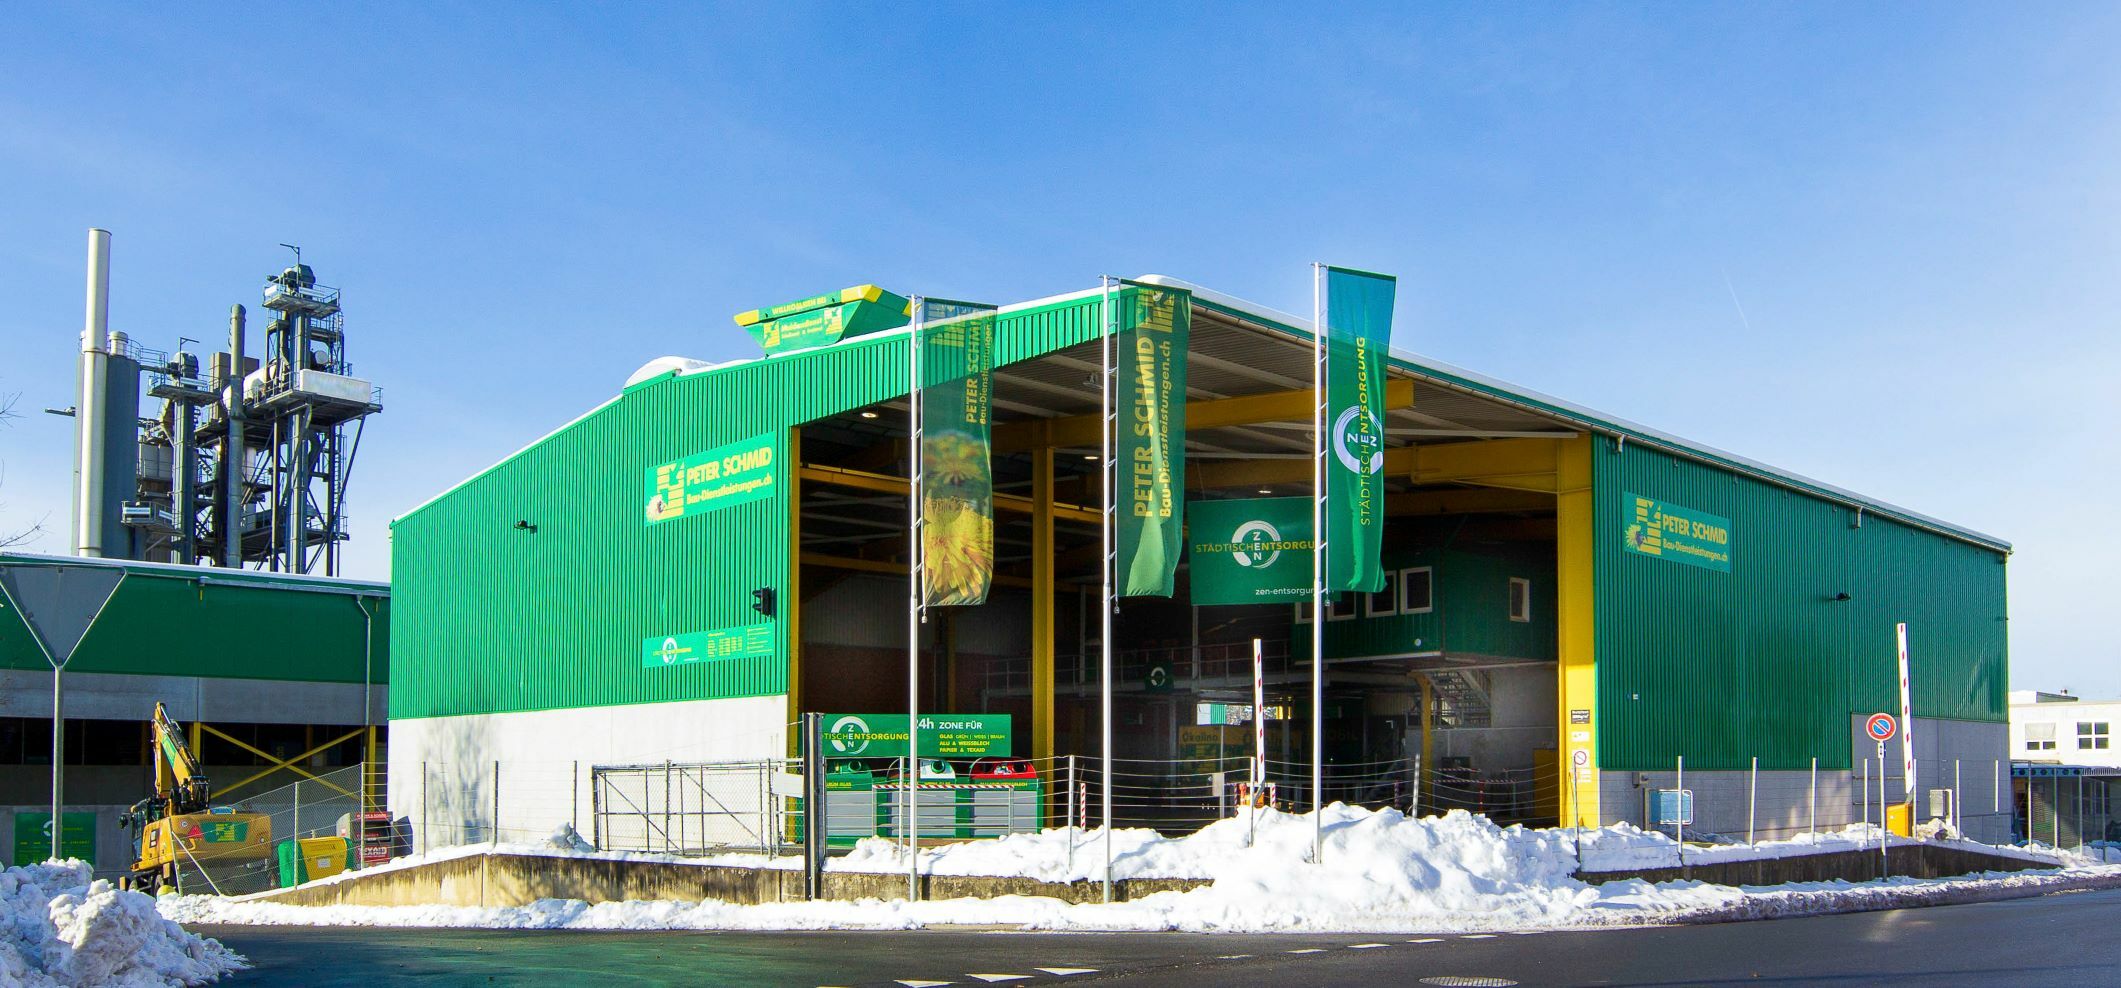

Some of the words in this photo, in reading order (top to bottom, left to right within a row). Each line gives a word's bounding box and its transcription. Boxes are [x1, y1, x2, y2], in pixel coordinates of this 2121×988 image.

[967, 312, 982, 373] SCHMI
[966, 378, 978, 423] PETER
[1134, 336, 1155, 438] SCHMID
[1158, 340, 1172, 518] Bau-Dienstleistungen.ch
[1356, 336, 1371, 526] STÄDTISCHENTSORGUNG
[687, 461, 720, 486] PETER
[723, 447, 772, 477] SCHMID
[1134, 446, 1153, 518] PETER
[686, 472, 772, 505] Bau-Dienstleistungen.ch
[1195, 540, 1324, 553] STÄDTISCHENTSORGU
[1662, 514, 1690, 537] PETER
[1692, 521, 1728, 545] SCHMID
[1663, 538, 1728, 562] Bau-Dienstleistungen.ch
[823, 732, 909, 740] TISCHENTSORGUNG
[939, 721, 964, 730] ZONE
[965, 720, 983, 730] FÜR
[356, 845, 388, 856] EXAID
